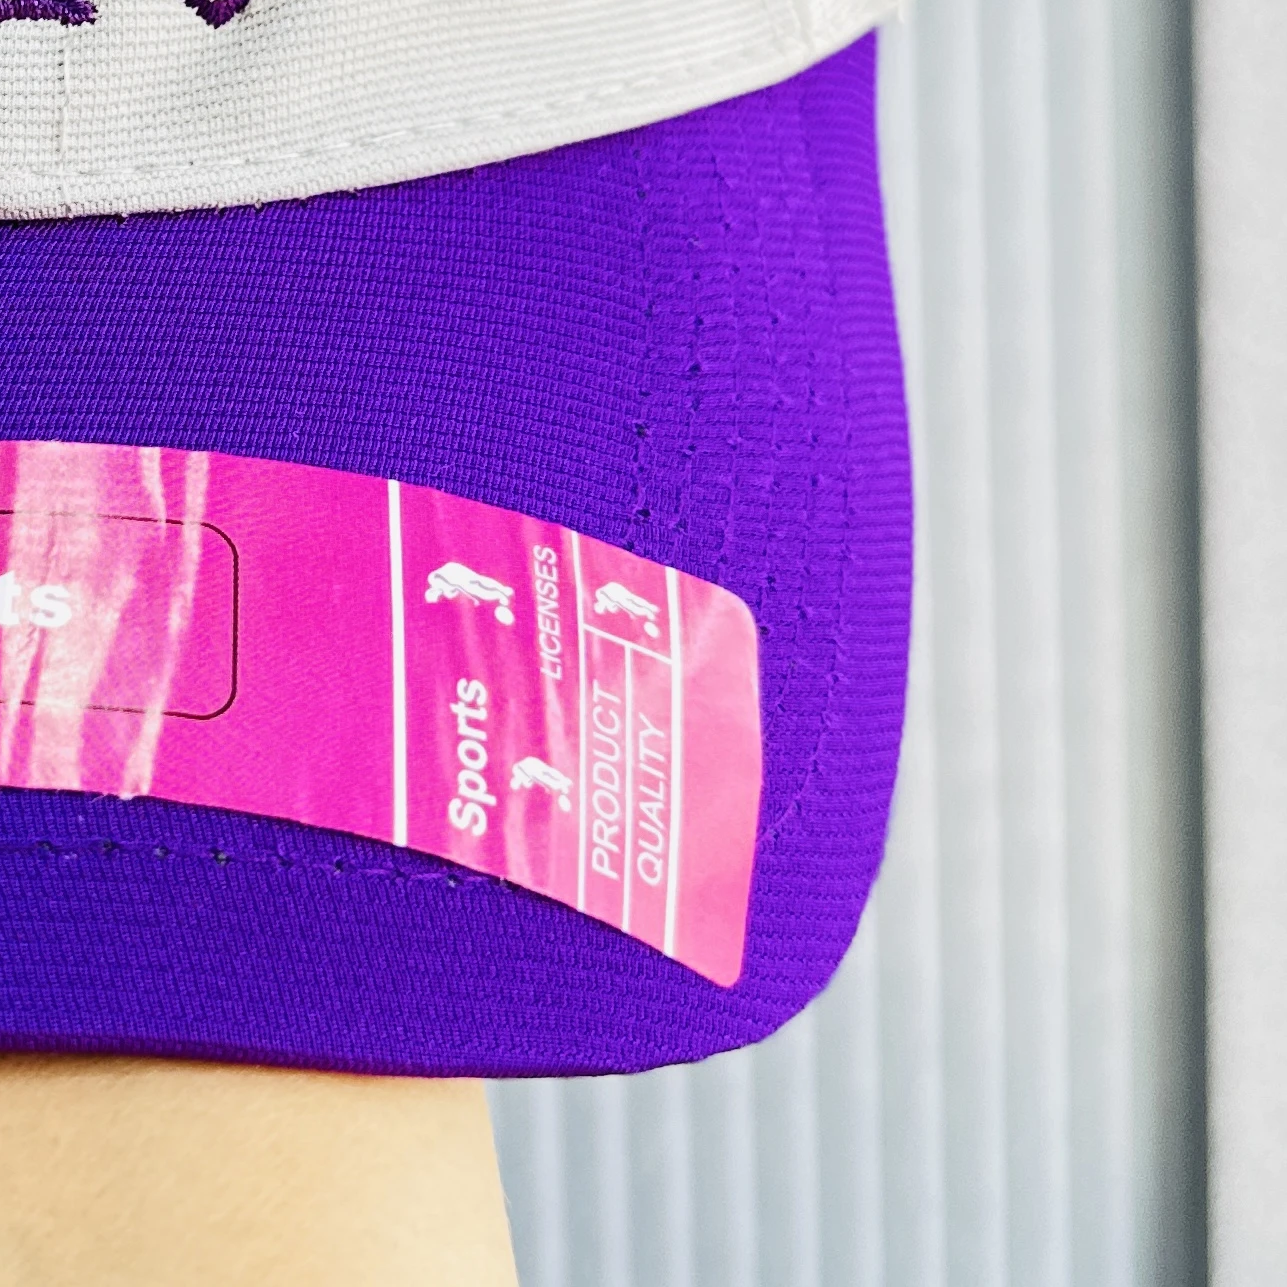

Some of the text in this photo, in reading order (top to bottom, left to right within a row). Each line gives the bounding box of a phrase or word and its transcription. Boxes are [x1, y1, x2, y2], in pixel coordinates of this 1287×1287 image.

[533, 544, 562, 681] LICENSES
[448, 678, 497, 836] Sports
[591, 679, 622, 881] PRODUCT
[636, 713, 666, 887] QUALITY
